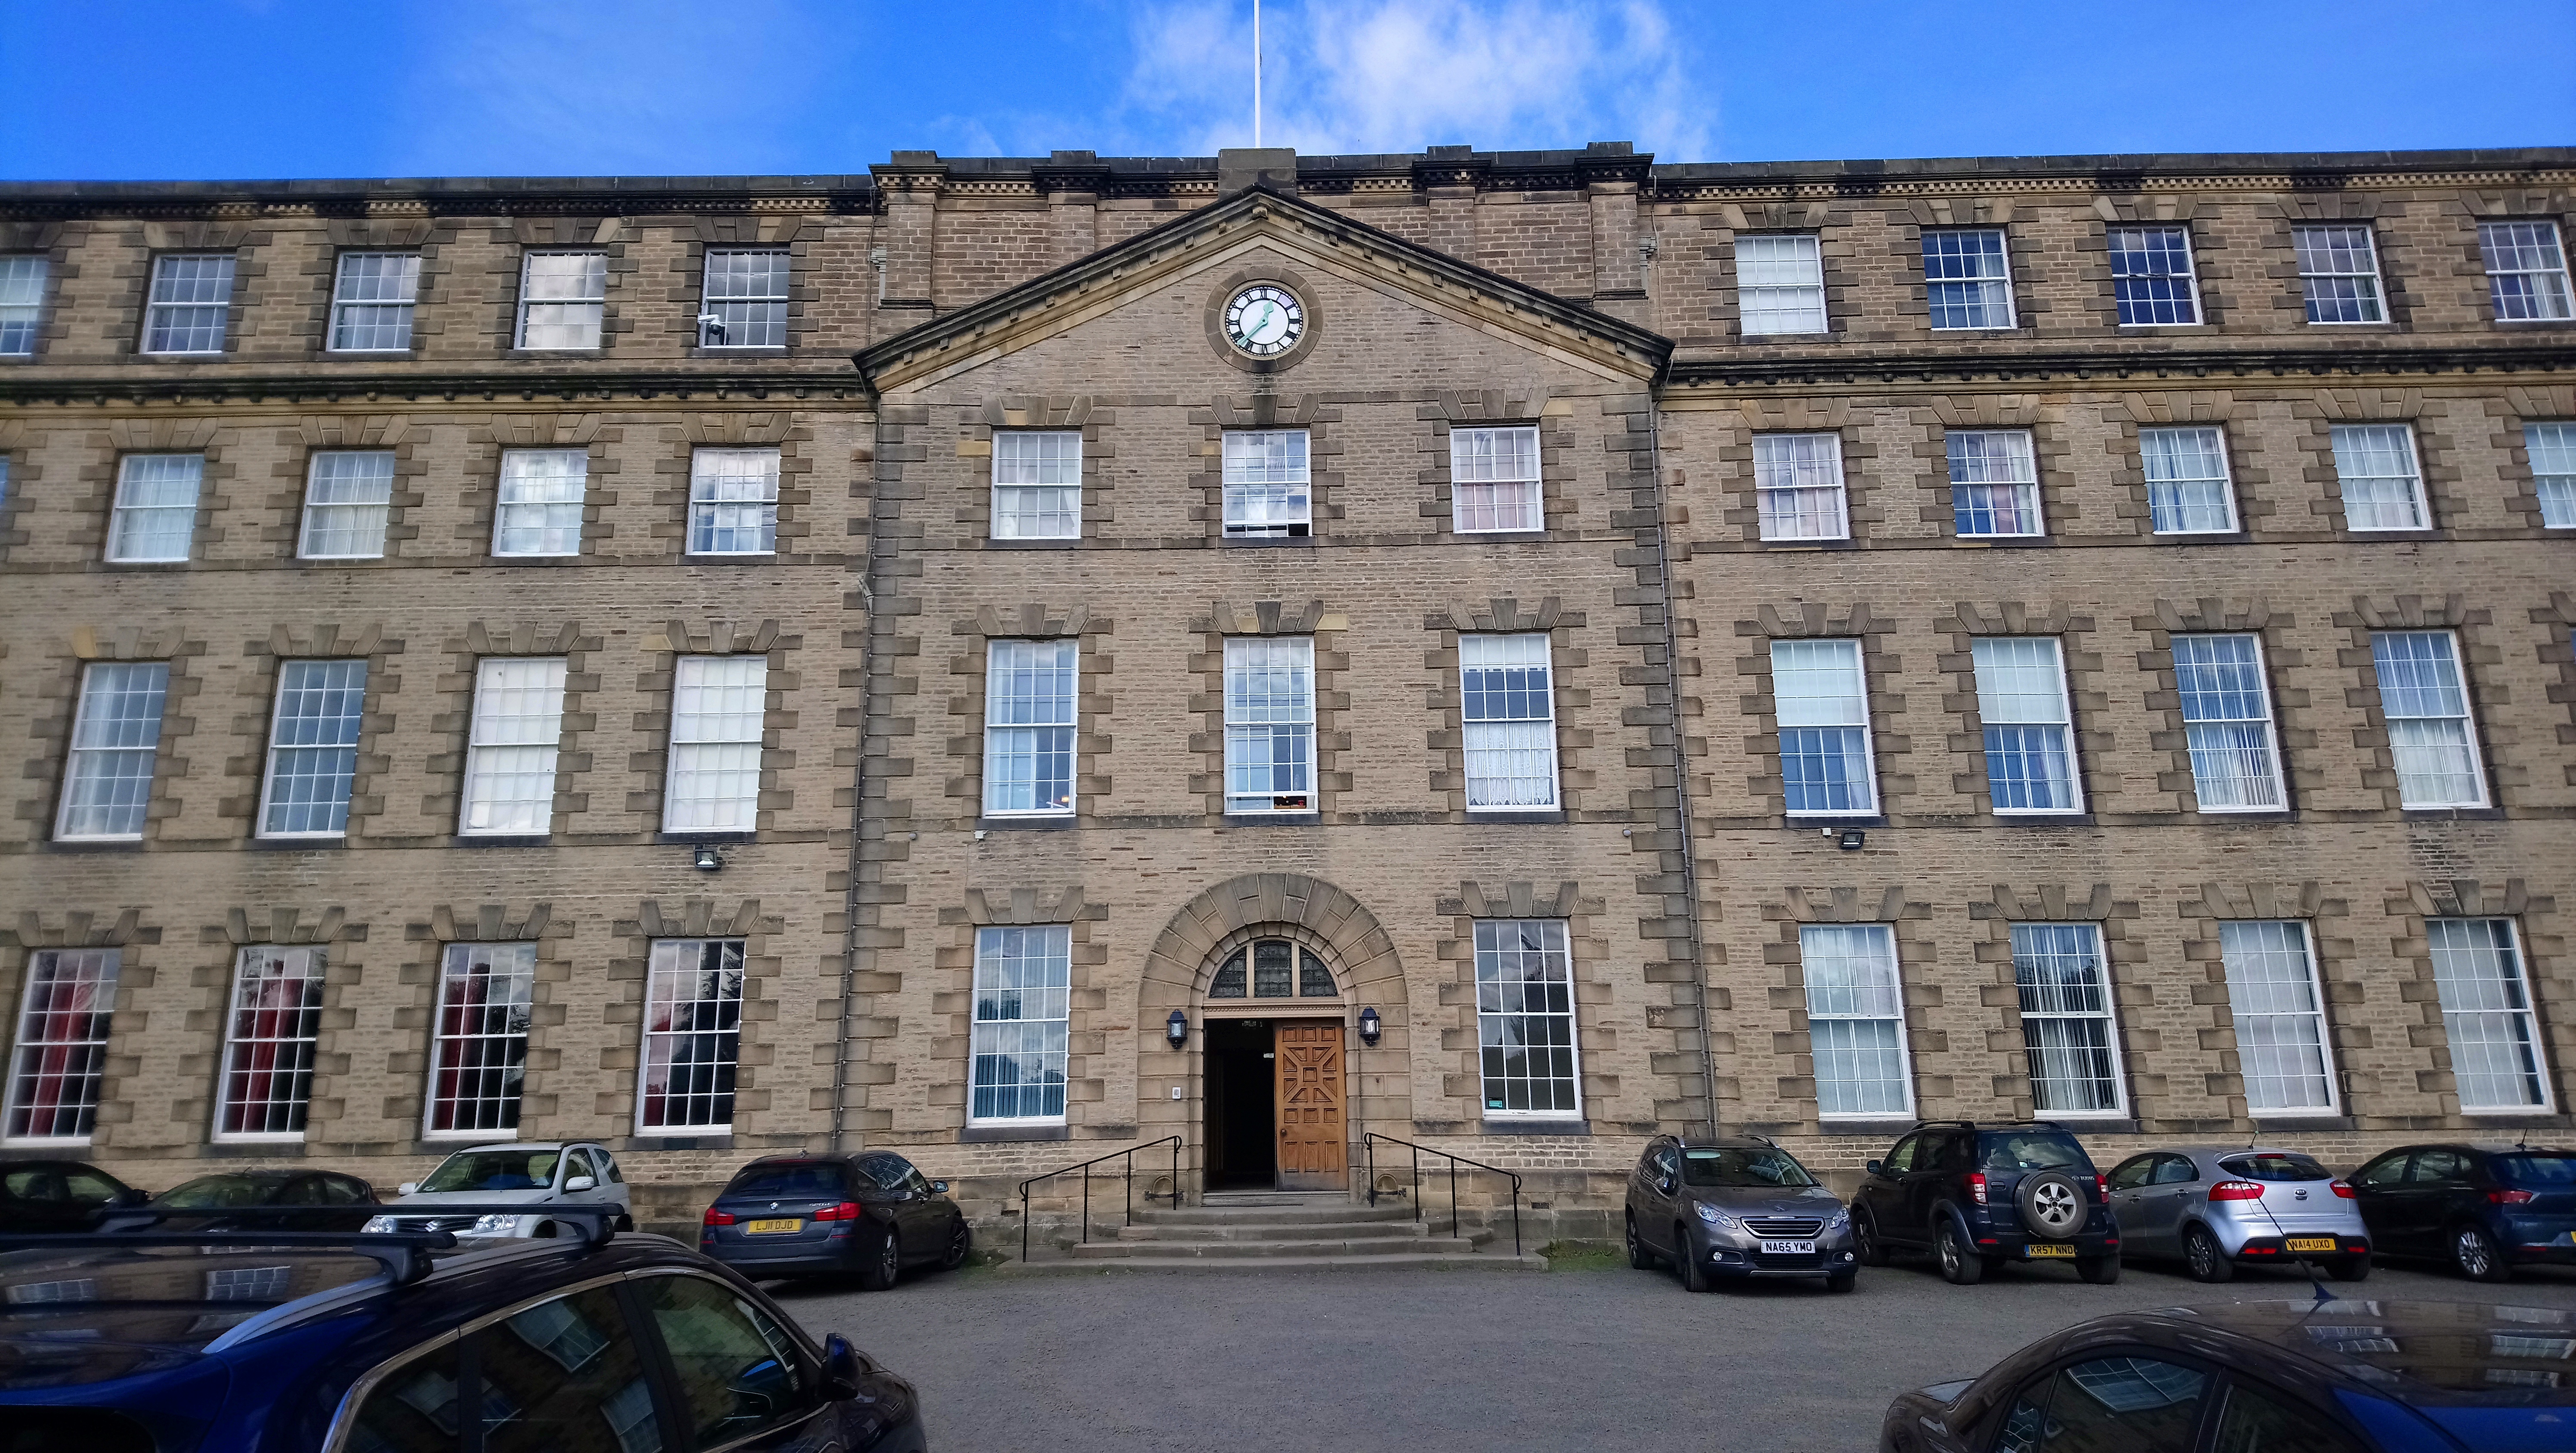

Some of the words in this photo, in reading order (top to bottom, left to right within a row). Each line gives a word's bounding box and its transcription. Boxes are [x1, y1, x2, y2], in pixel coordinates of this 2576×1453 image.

[756, 1221, 773, 1230] LJ11
[775, 1221, 793, 1230] DJD
[1766, 1243, 1791, 1251] NA65
[1794, 1243, 1812, 1251] YMO
[2031, 1246, 2053, 1254] KR57
[2056, 1246, 2073, 1254] NND
